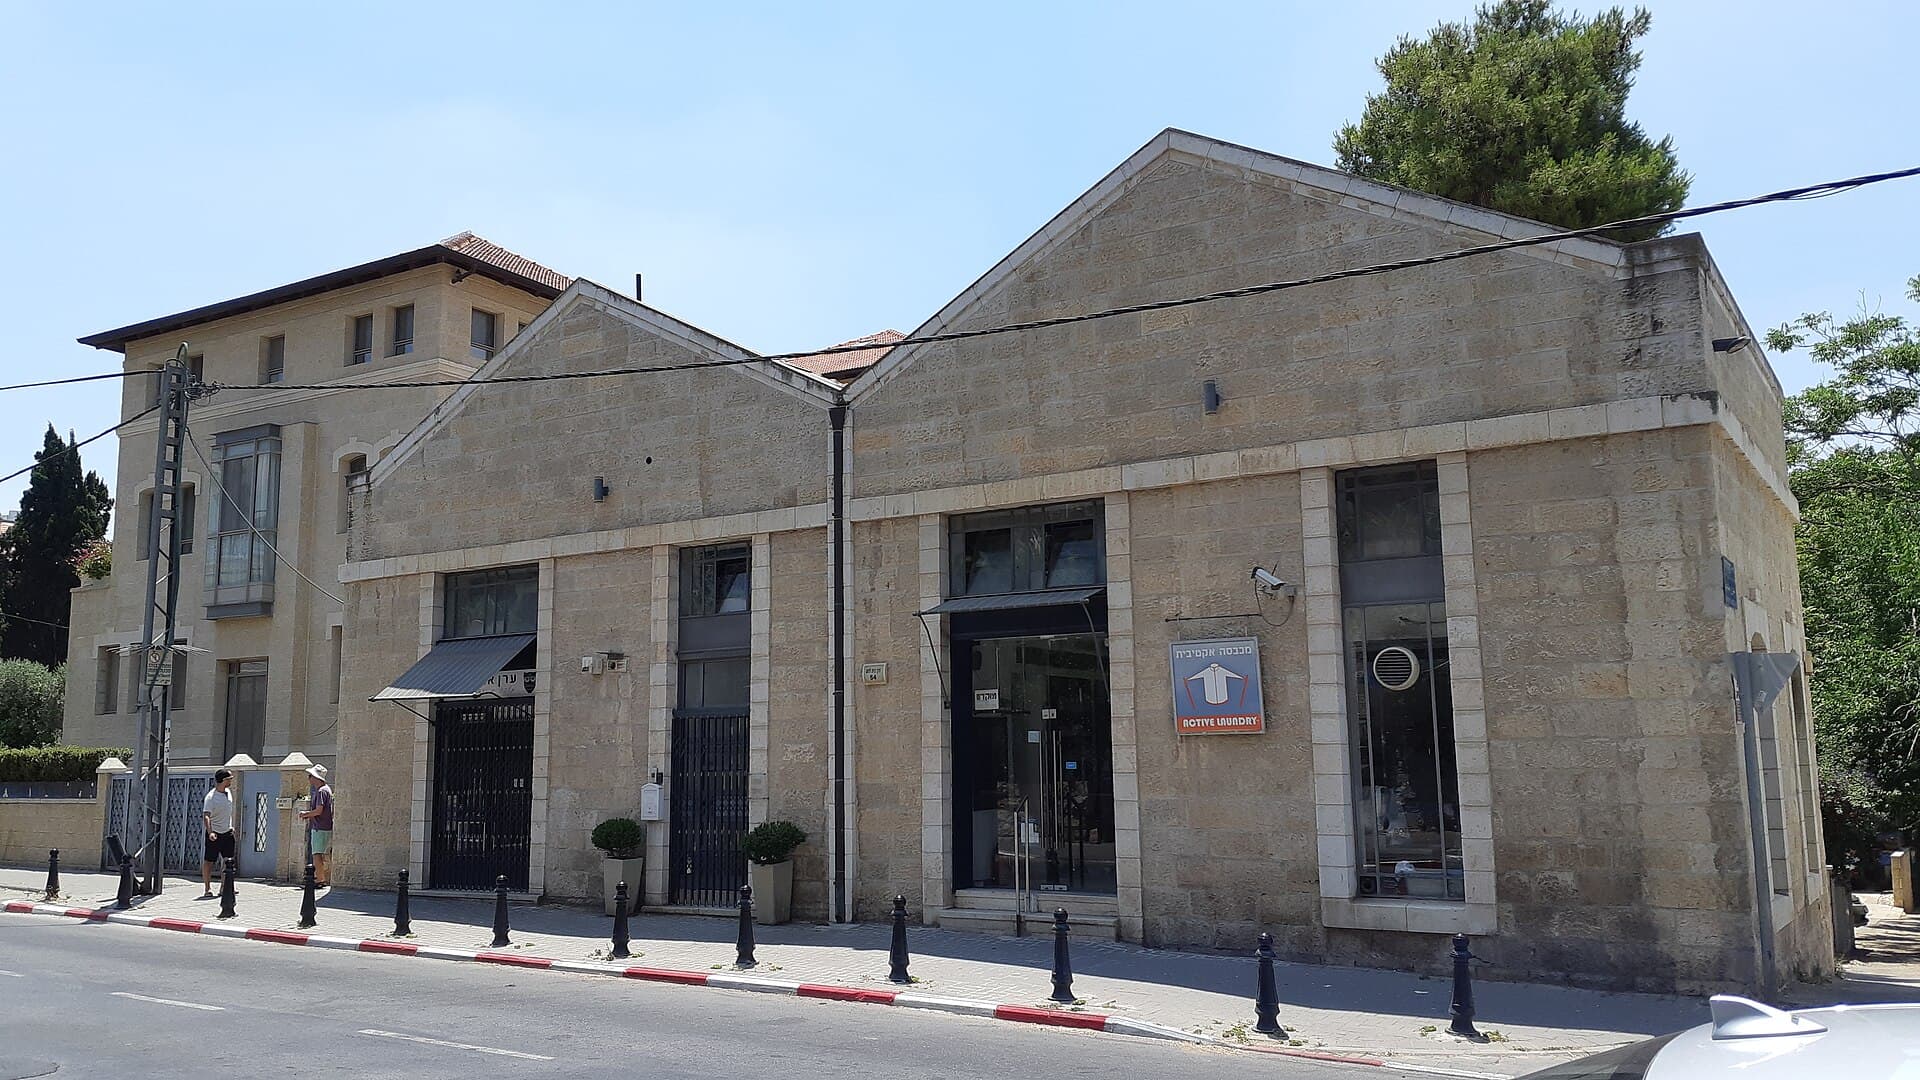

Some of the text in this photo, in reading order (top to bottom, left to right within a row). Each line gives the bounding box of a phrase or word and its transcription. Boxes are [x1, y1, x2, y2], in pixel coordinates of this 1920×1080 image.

[1176, 646, 1252, 659] מכבסה אקטיבית
[497, 674, 517, 687] ערן
[1183, 716, 1257, 728] ACTIVE LAUNDRY
